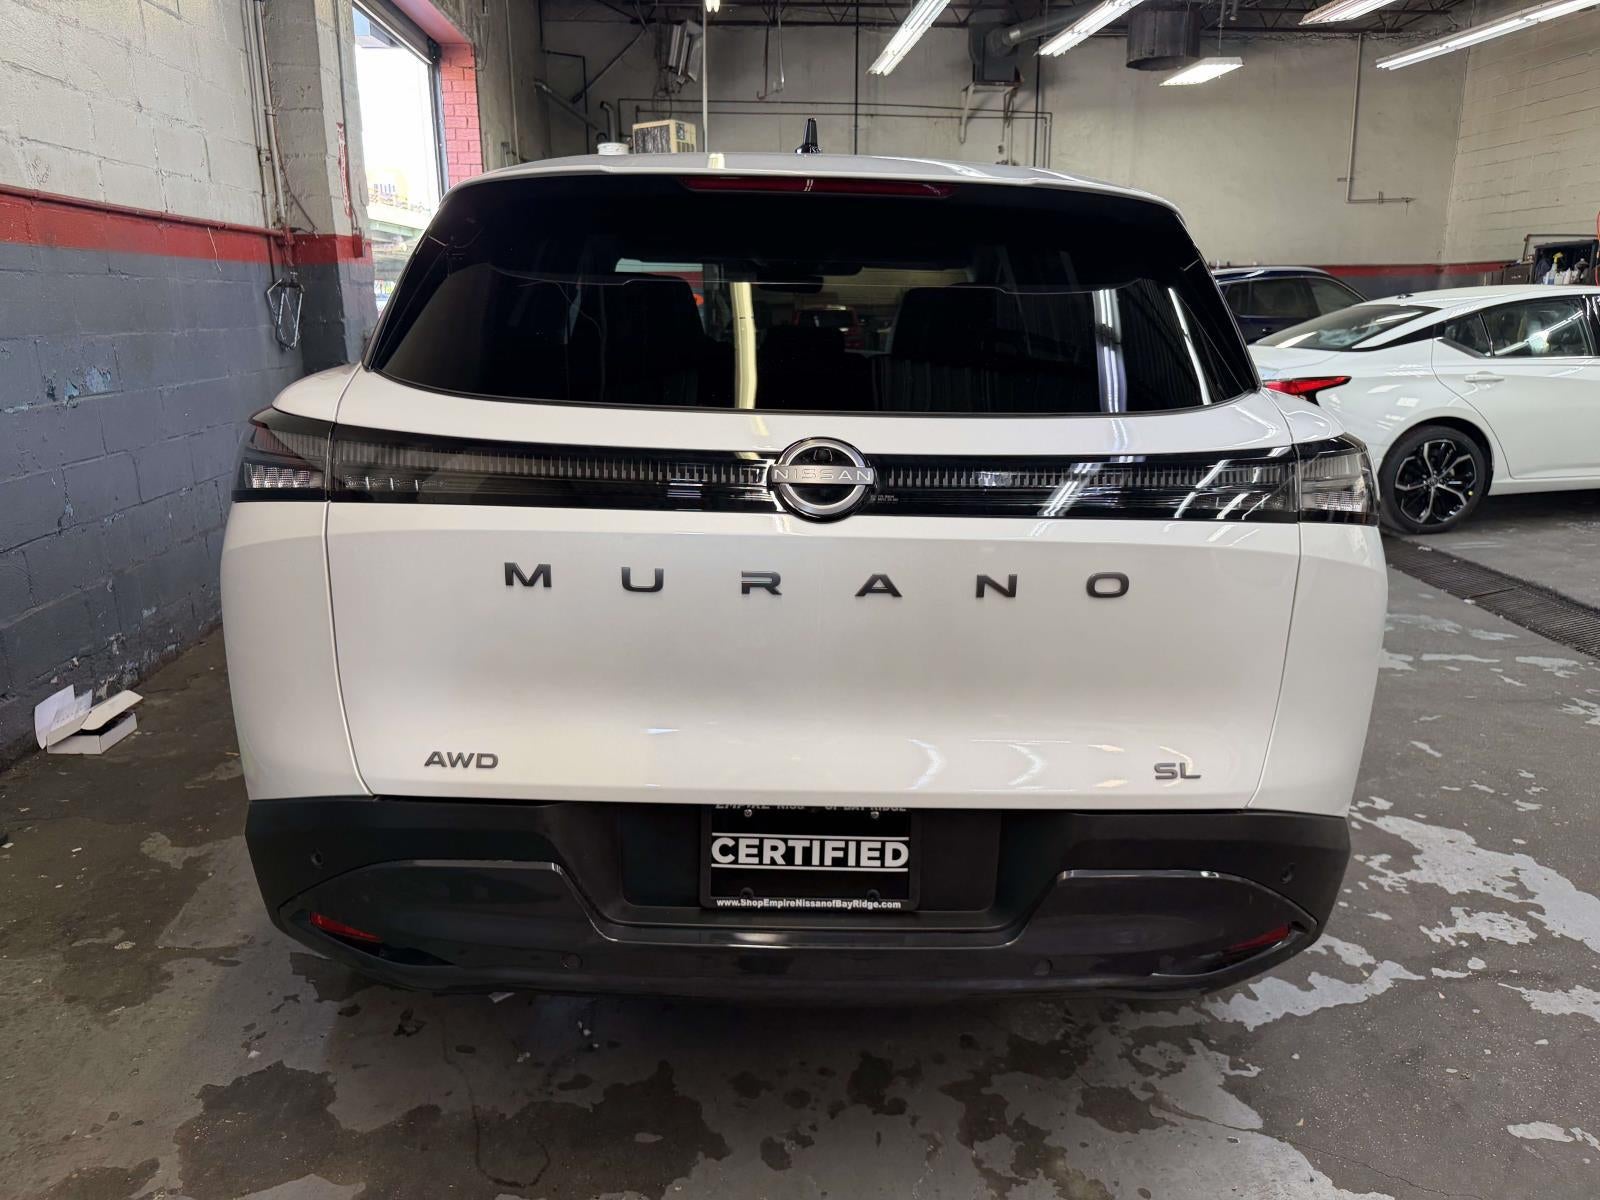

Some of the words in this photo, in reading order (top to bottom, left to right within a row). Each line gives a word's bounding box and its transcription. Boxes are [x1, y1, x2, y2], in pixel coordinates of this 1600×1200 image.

[774, 468, 871, 481] NISSAN
[504, 562, 1130, 599] MURANO
[423, 751, 499, 769] AWD
[1153, 762, 1202, 780] SL
[711, 836, 910, 868] CERTIFIED
[716, 898, 902, 910] www.ShopEmpireNissanofBayRidge.com
